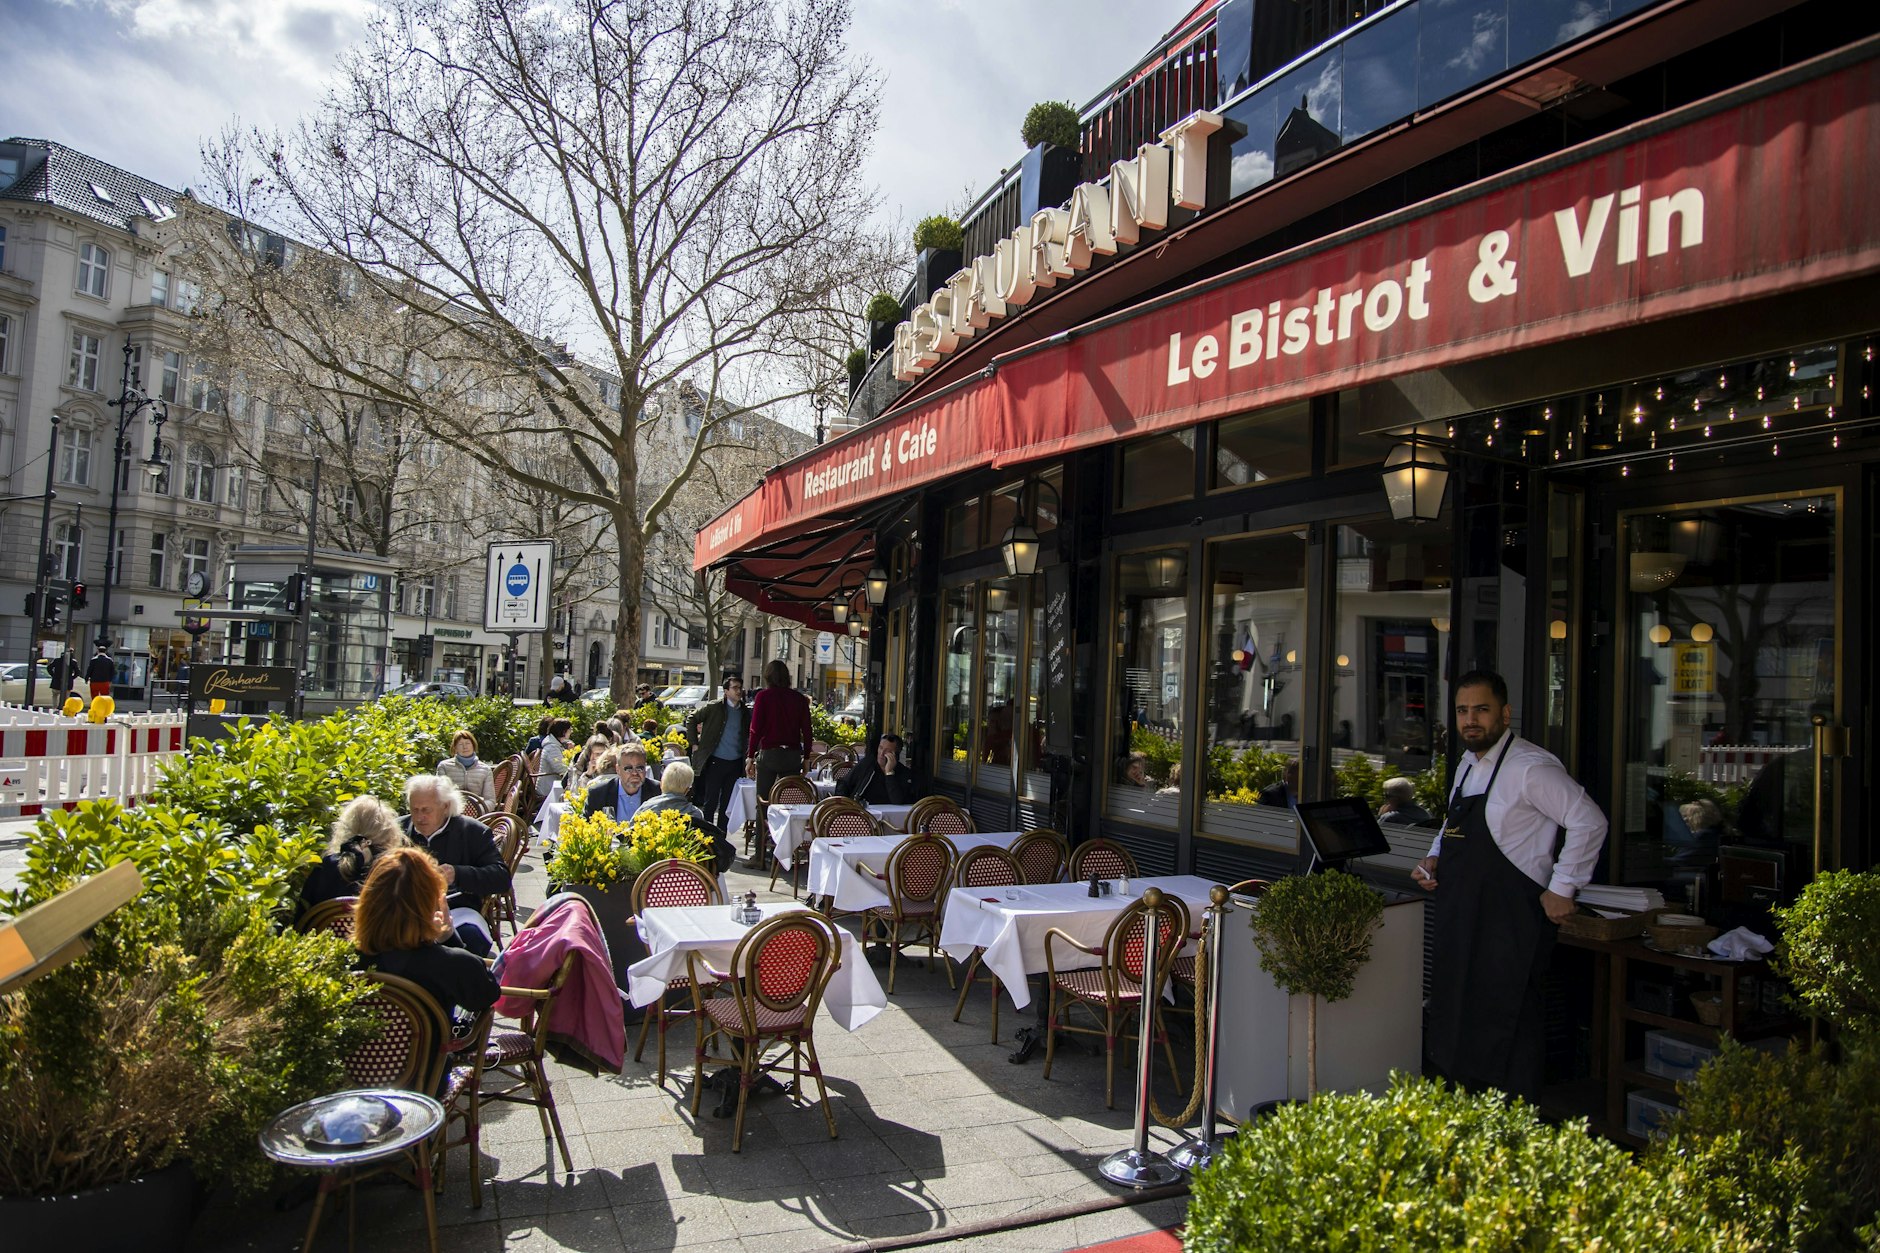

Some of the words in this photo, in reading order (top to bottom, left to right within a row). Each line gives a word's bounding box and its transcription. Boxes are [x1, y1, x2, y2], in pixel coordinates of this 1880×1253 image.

[893, 109, 1224, 382] RESTAURANT
[1166, 331, 1219, 388] Le
[1228, 256, 1432, 370] Bistrot
[1466, 229, 1518, 304] &
[1553, 185, 1705, 279] Vin
[804, 446, 875, 500] Restaurant
[881, 437, 892, 472] &
[203, 669, 270, 695] Reinhard's
